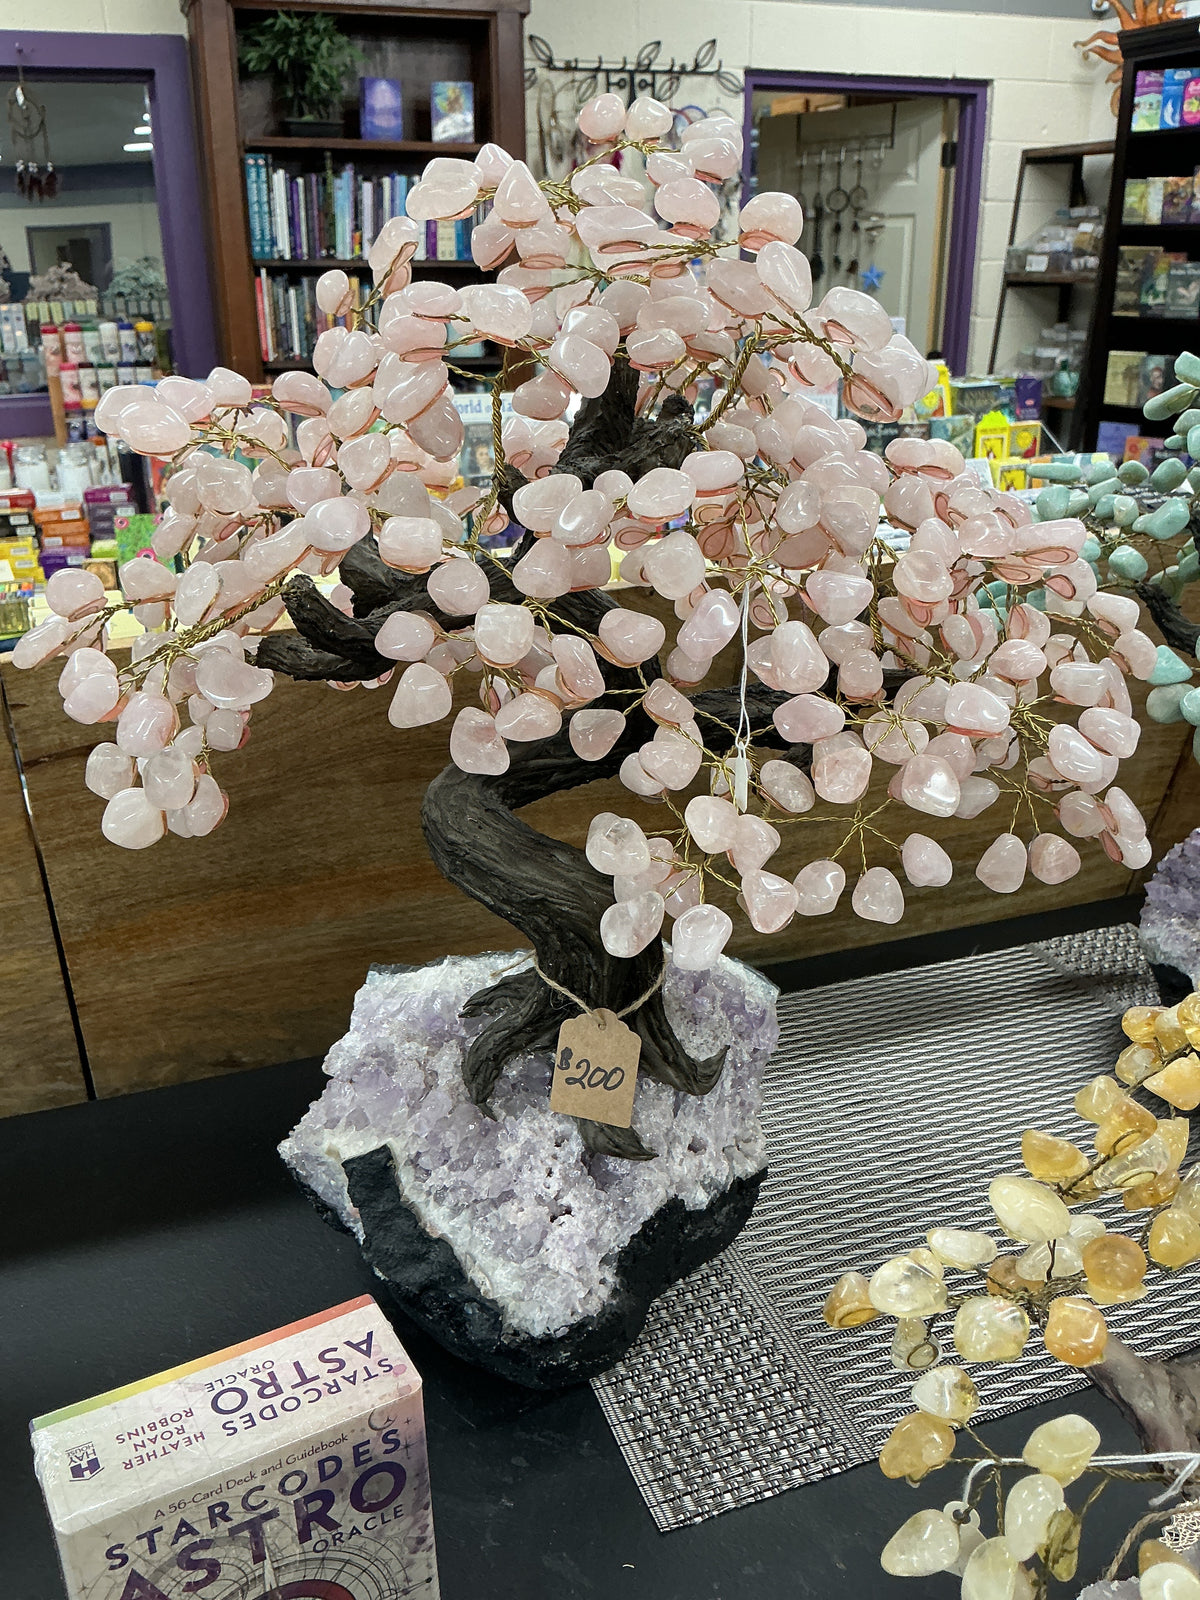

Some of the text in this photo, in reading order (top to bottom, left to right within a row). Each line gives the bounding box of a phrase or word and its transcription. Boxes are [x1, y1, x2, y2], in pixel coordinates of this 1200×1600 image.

[453, 399, 482, 414] orld
[556, 1046, 625, 1091] $200
[204, 1360, 275, 1393] ORACLE
[211, 1330, 374, 1416] ASTRO
[222, 1358, 394, 1437] STARCODES
[115, 1407, 195, 1445] ROBBINS
[133, 1424, 187, 1453] ROAN
[67, 1444, 94, 1457] HOUSE
[68, 1448, 96, 1466] HAY
[122, 1431, 206, 1471] HEATHER
[153, 1432, 349, 1521] A 56-Card Deck and Guidebook
[104, 1428, 402, 1571] STARCODES
[119, 1460, 408, 1600] ASTRO
[311, 1503, 405, 1554] ORACLE
